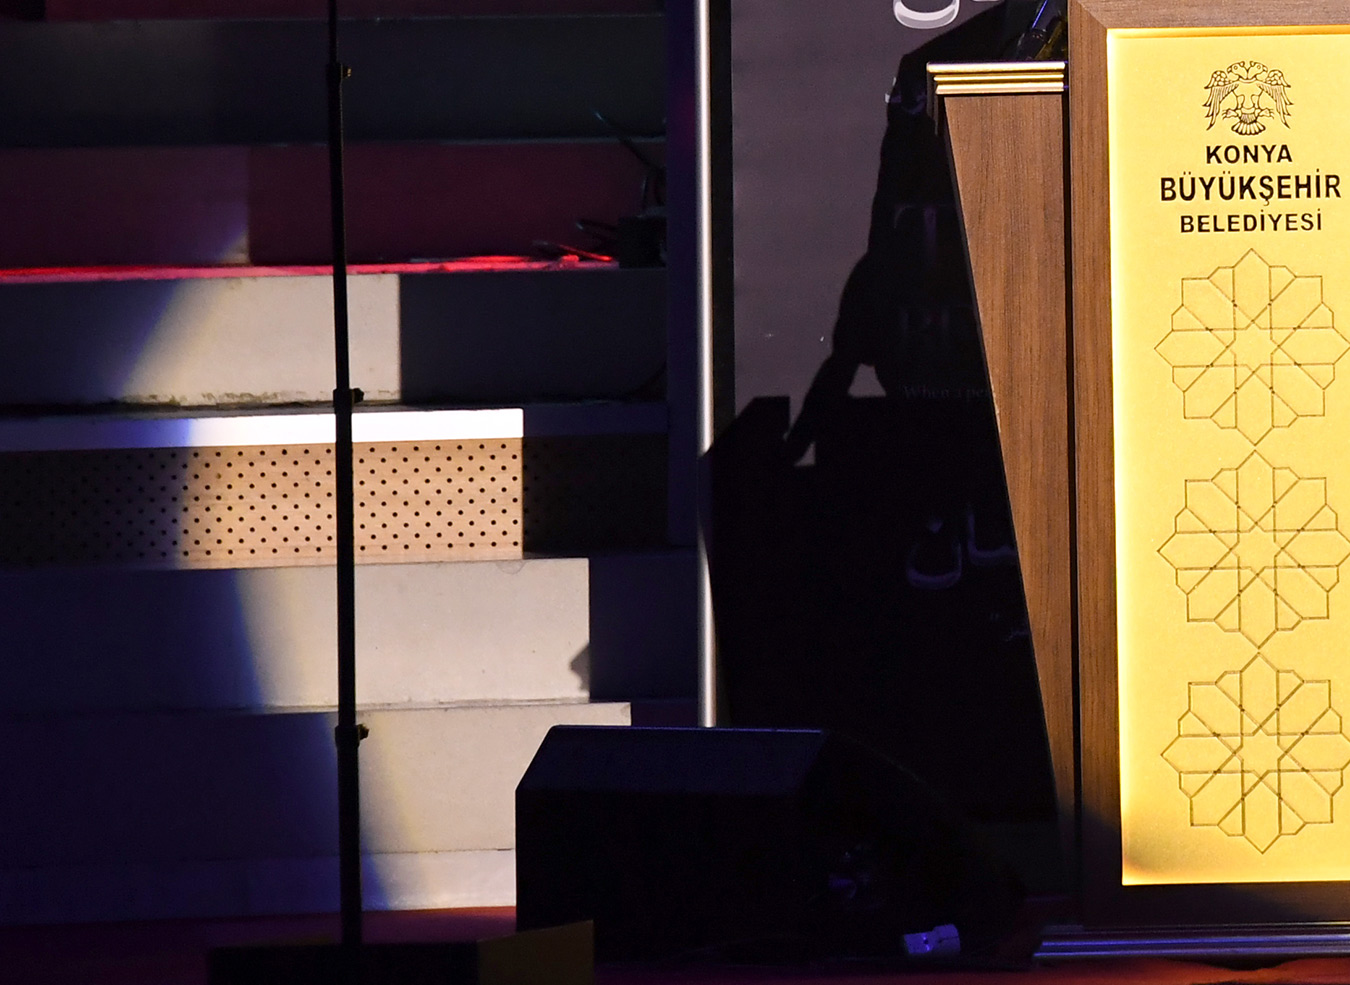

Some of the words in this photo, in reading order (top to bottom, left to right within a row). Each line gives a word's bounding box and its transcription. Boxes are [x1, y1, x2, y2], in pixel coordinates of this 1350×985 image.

[1206, 144, 1293, 164] KONYA
[1160, 168, 1342, 206] BÜYÜKŞEHİR
[1180, 208, 1322, 233] BELEDİYESİ
